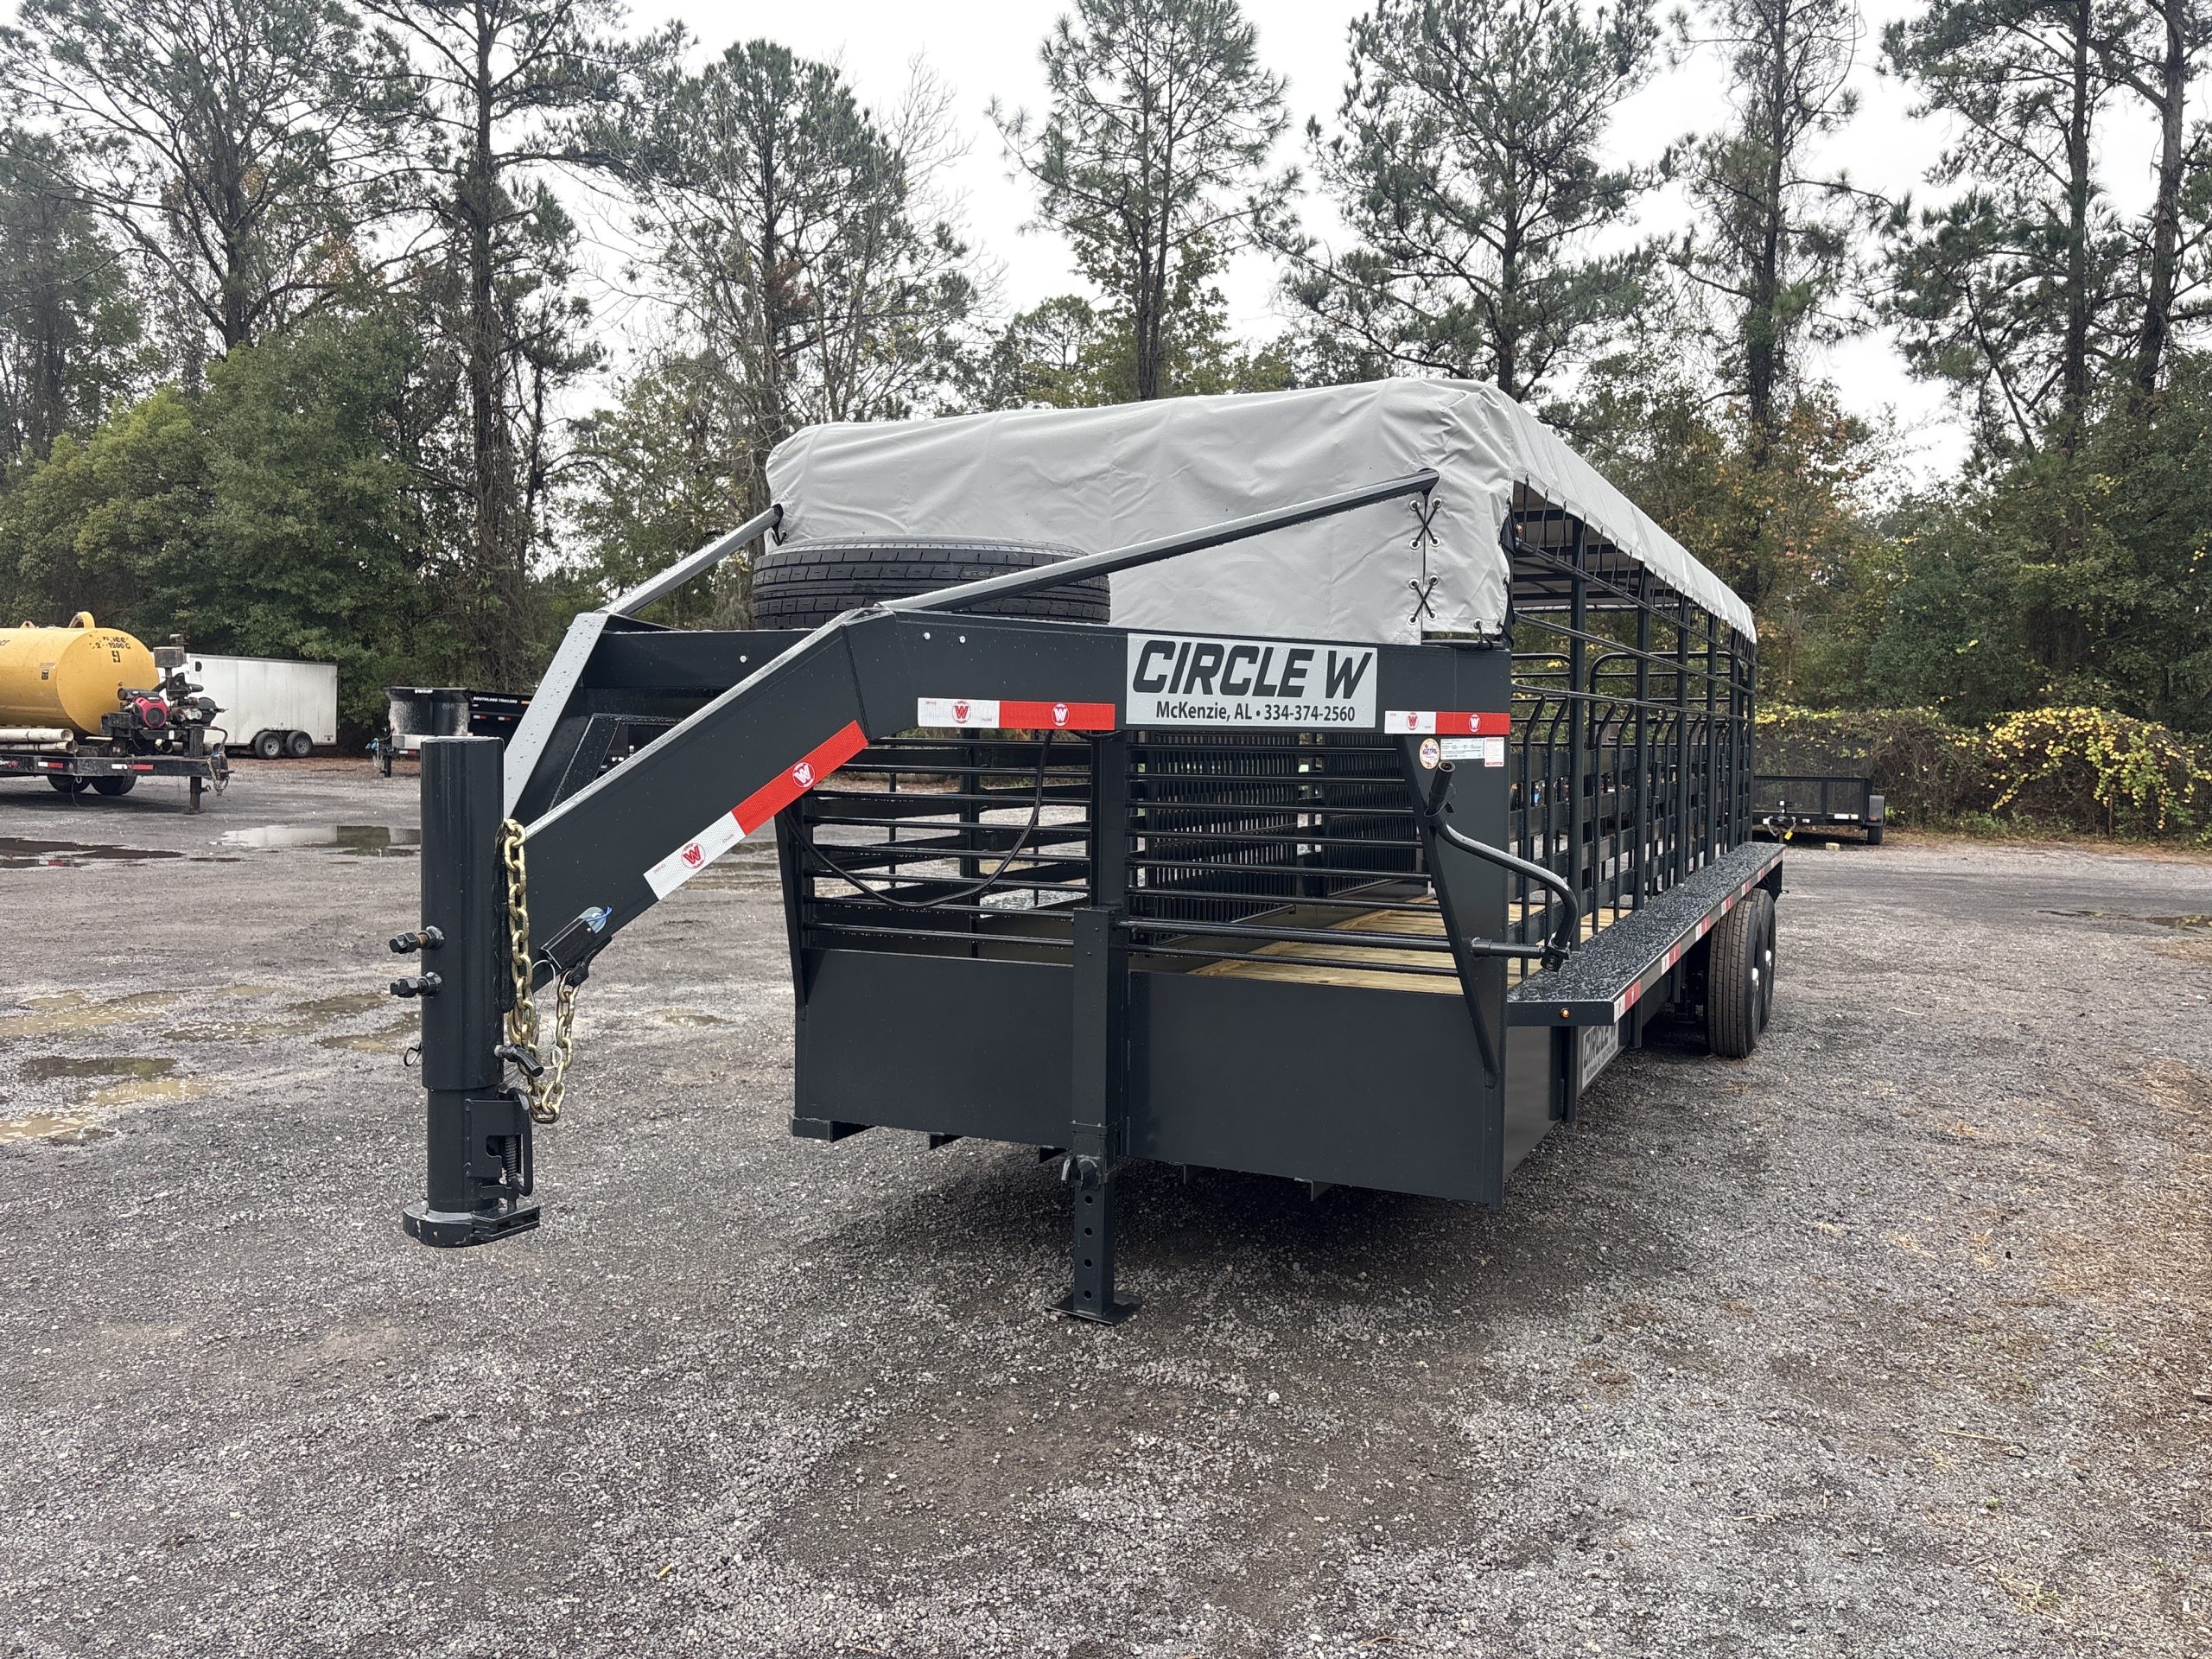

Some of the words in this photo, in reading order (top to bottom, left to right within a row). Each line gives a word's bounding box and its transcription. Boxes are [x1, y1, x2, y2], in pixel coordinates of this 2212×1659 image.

[1133, 639, 1315, 698] CIRCLE
[1325, 650, 1374, 700] W
[954, 704, 969, 720] W
[1052, 707, 1068, 722] W
[1156, 701, 1230, 722] McKenzie,
[1234, 702, 1252, 720] AL
[1264, 703, 1356, 722] 334-374-2560
[793, 764, 812, 784] W
[682, 845, 702, 865] W
